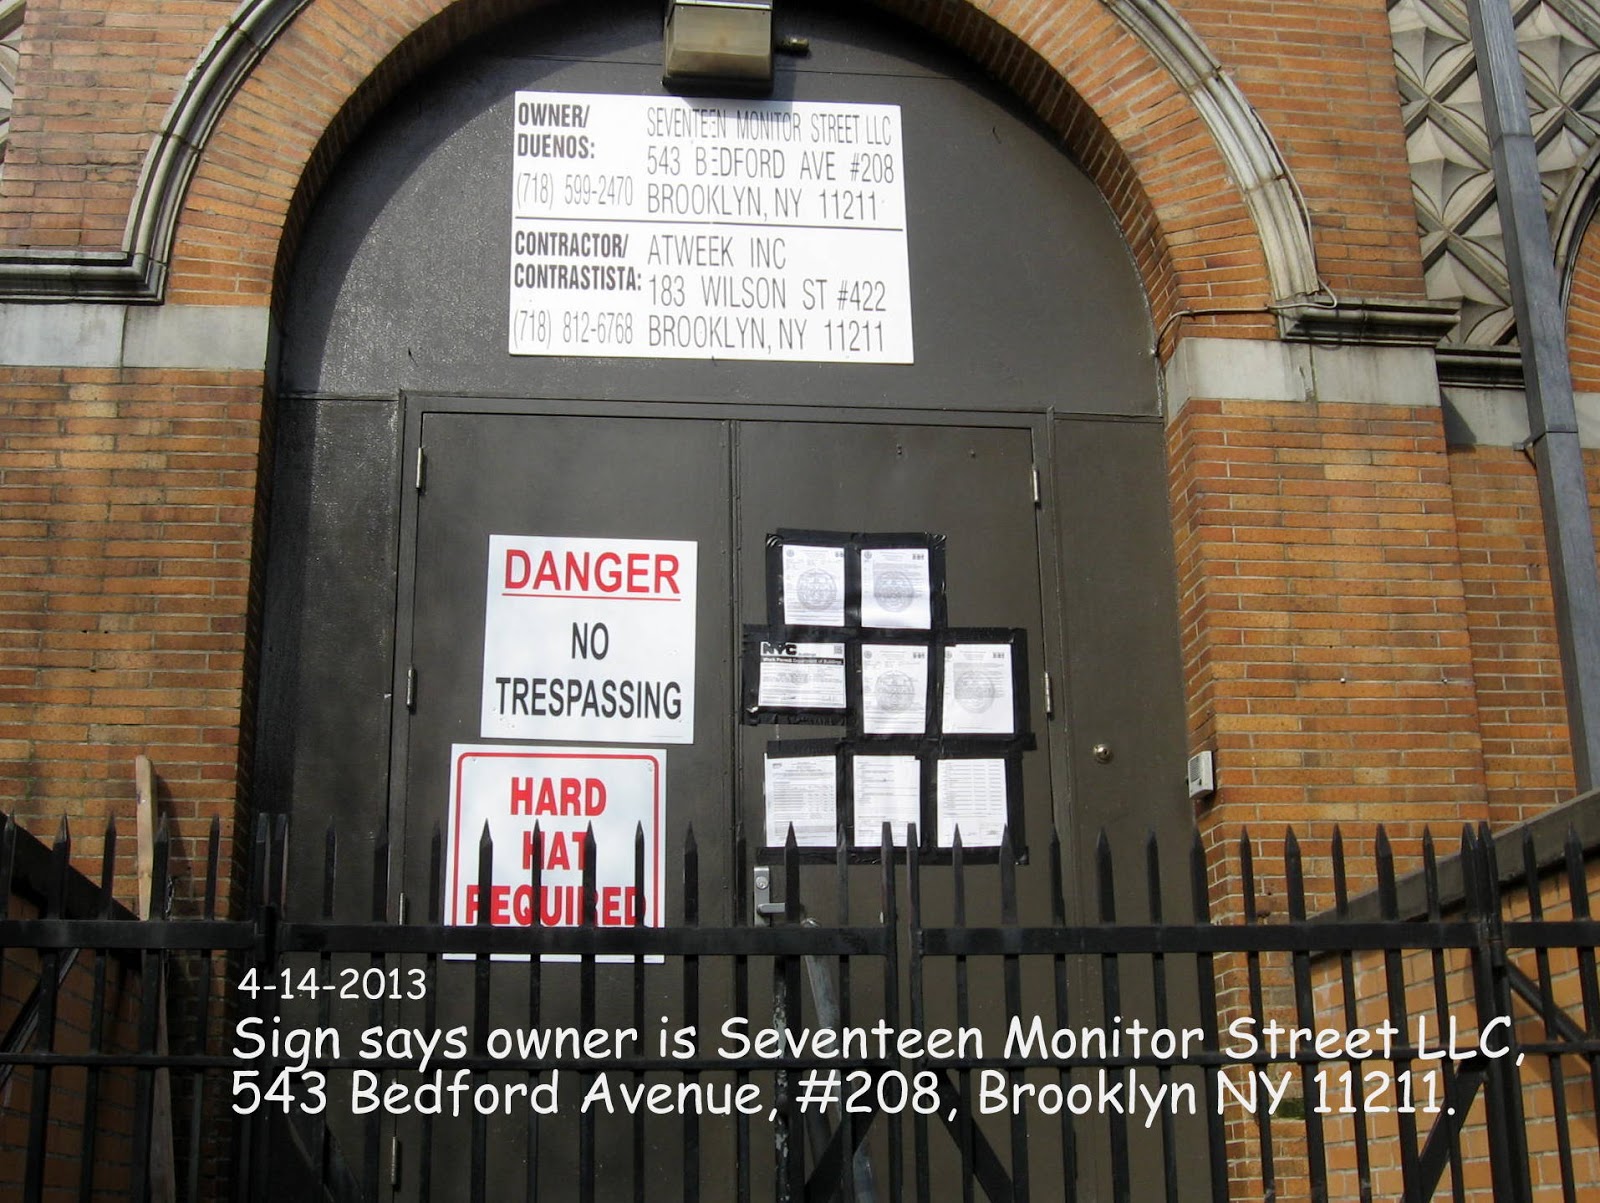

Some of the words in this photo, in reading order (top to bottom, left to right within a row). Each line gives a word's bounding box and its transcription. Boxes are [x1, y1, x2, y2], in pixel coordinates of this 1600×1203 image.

[518, 102, 590, 128] OWNER/
[647, 107, 726, 139] SEVENTEEN
[737, 110, 801, 142] MONITOR
[811, 113, 860, 144] STREET
[866, 115, 892, 146] LLC
[517, 133, 595, 159] DUENOS:
[647, 146, 680, 176] 543
[696, 147, 785, 179] BEDFORD
[800, 151, 836, 181] AVE
[850, 152, 894, 184] #208
[517, 172, 554, 210] (718)
[565, 173, 633, 206] 599-2470
[819, 189, 876, 220] 11211
[515, 230, 629, 259] CONTRACTOR/
[648, 234, 734, 267] ATWEEK
[750, 237, 786, 270] INC
[514, 263, 642, 291] CONTRASTISTA:
[649, 274, 685, 307] 183
[701, 275, 786, 309] WILSON
[802, 278, 828, 310] ST
[837, 279, 886, 312] #422
[514, 310, 551, 349] (718)
[563, 311, 633, 344] 812-6768
[824, 319, 883, 352] 11211
[504, 549, 680, 594] DANGER
[571, 621, 609, 660] NO
[763, 642, 797, 656] NYC
[495, 676, 682, 720] TRESPASSING
[510, 777, 607, 816] HARD
[522, 831, 590, 870] HAT
